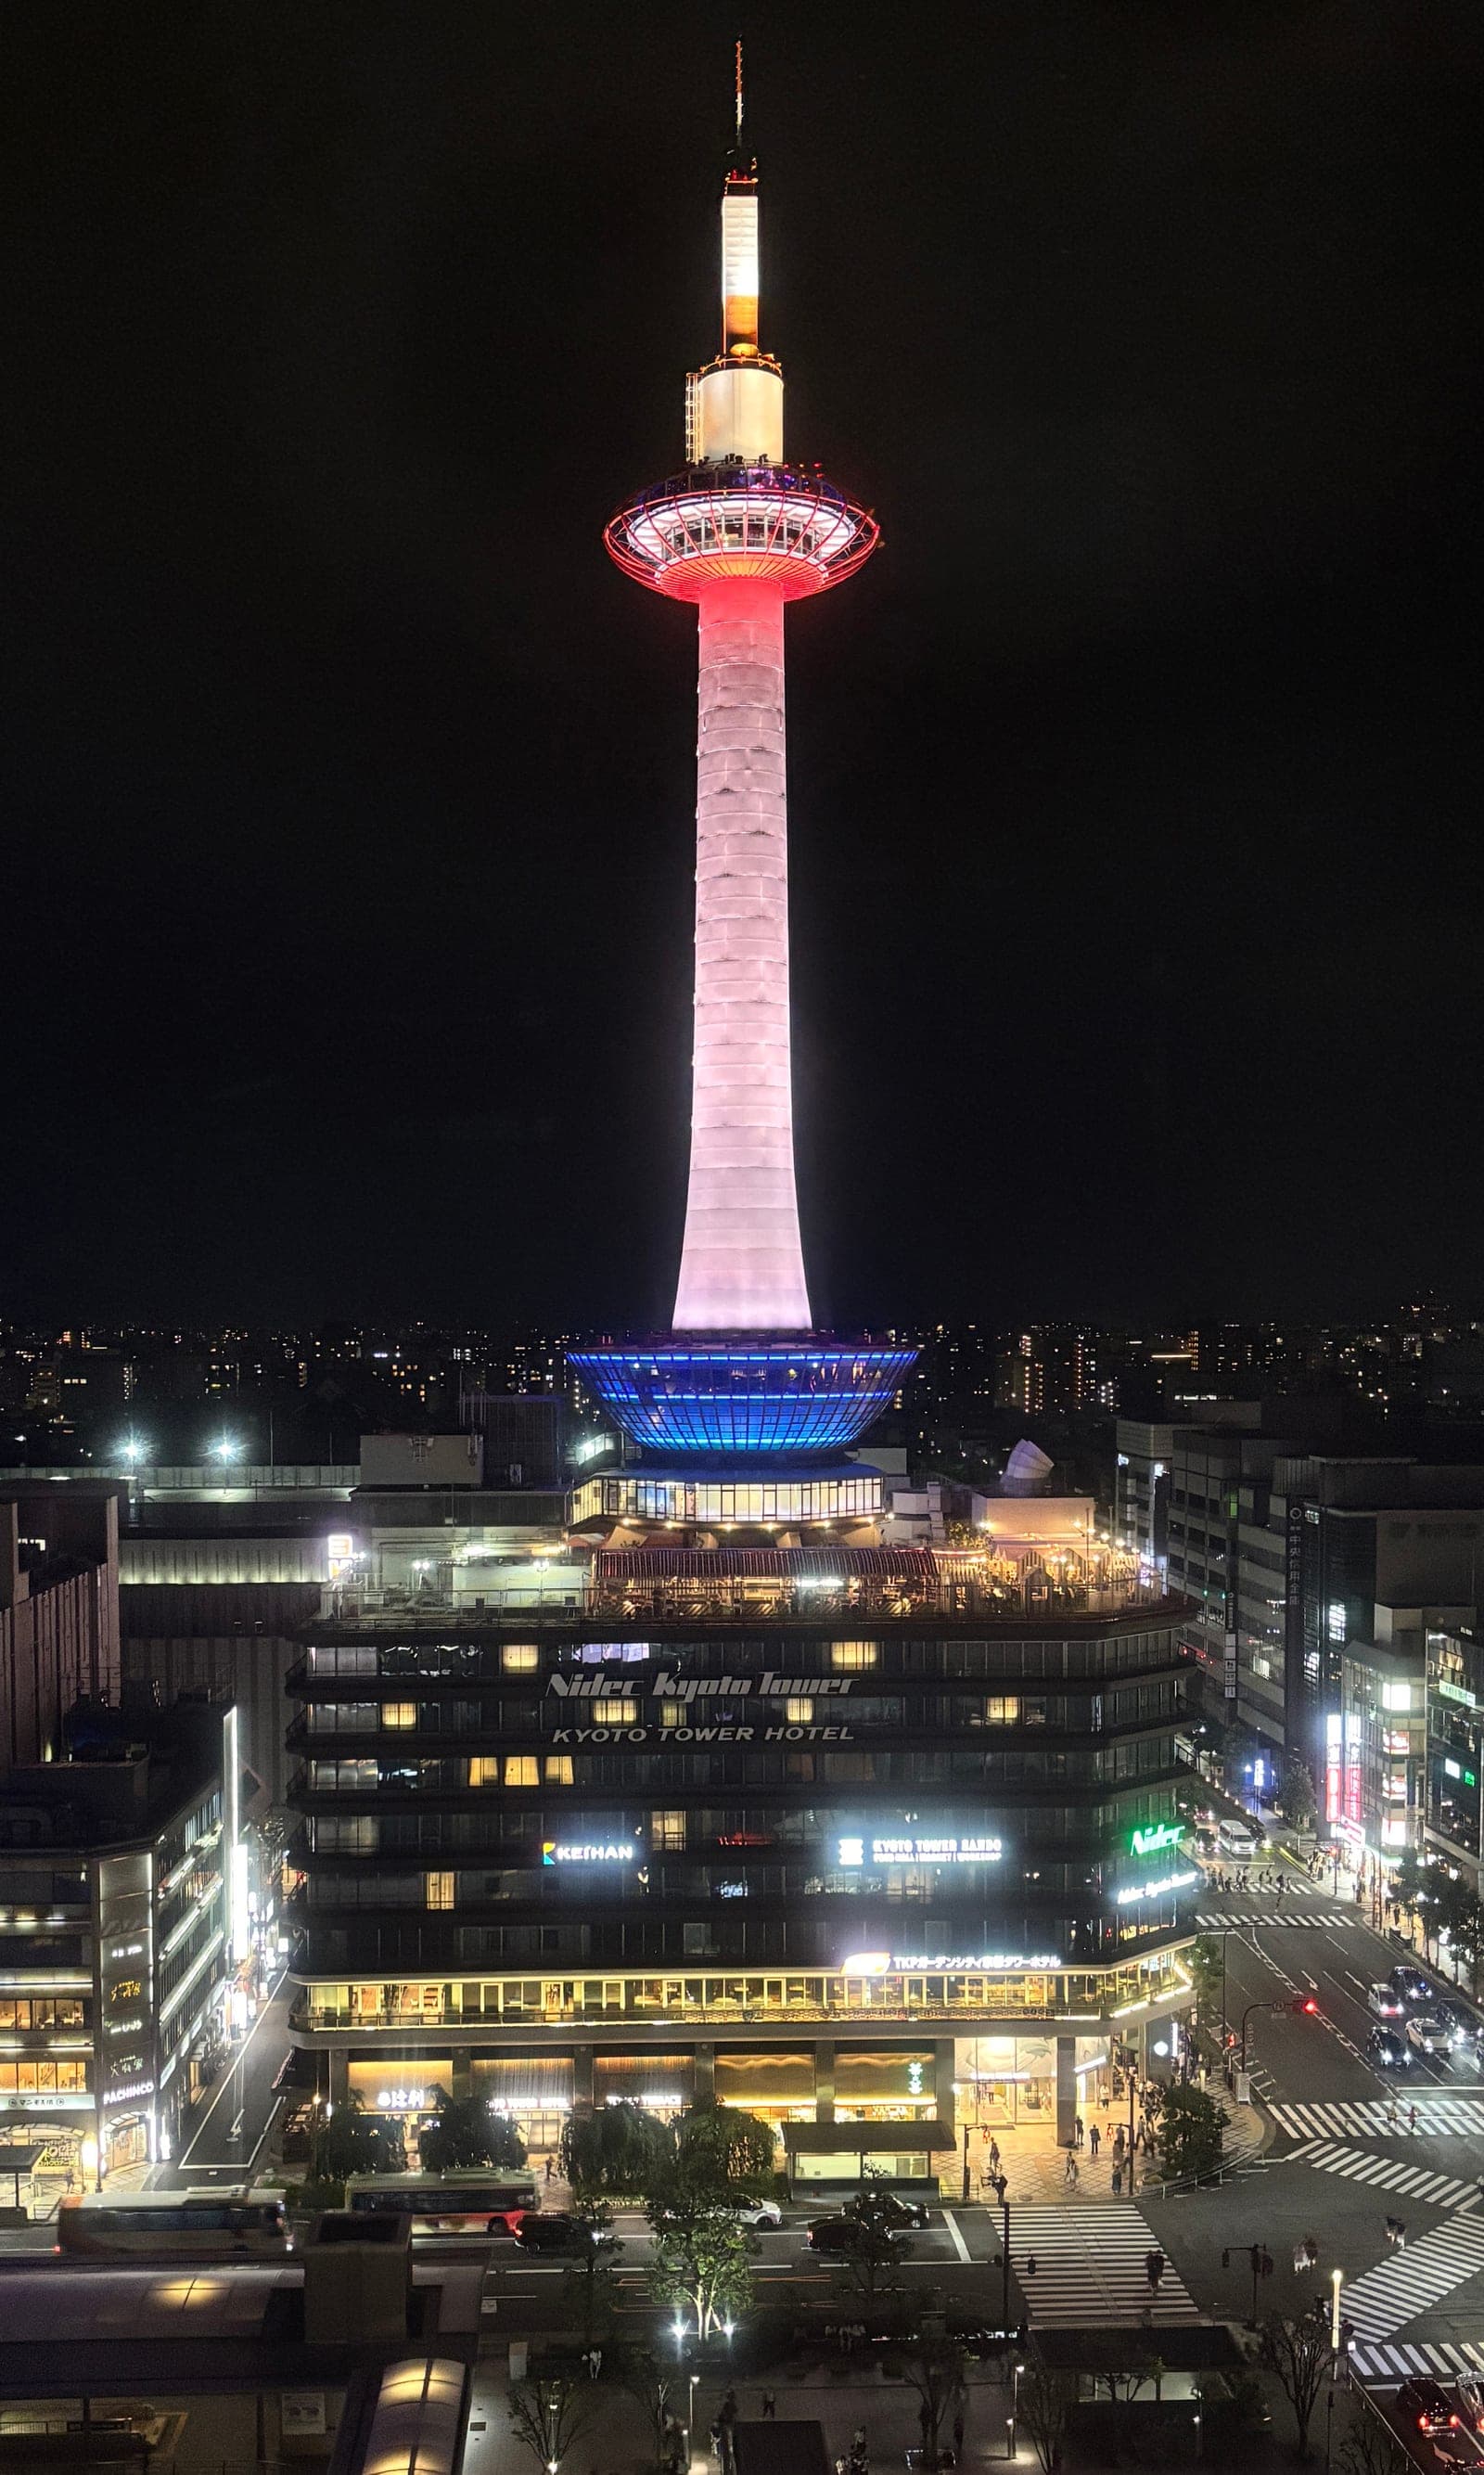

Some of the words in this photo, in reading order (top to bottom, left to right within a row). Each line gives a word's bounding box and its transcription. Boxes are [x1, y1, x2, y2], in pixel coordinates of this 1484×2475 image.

[545, 1673, 645, 1697] Nidec
[652, 1673, 752, 1703] Kyoto
[759, 1671, 860, 1695] Tower
[553, 1728, 647, 1743] KYOTO
[658, 1726, 754, 1742] TOWER
[764, 1726, 854, 1741] HOTEL
[873, 1840, 914, 1853] KYOTO
[915, 1840, 957, 1852] TOWER
[1131, 1824, 1185, 1856] Nidec
[556, 1845, 633, 1860] KEIHAN
